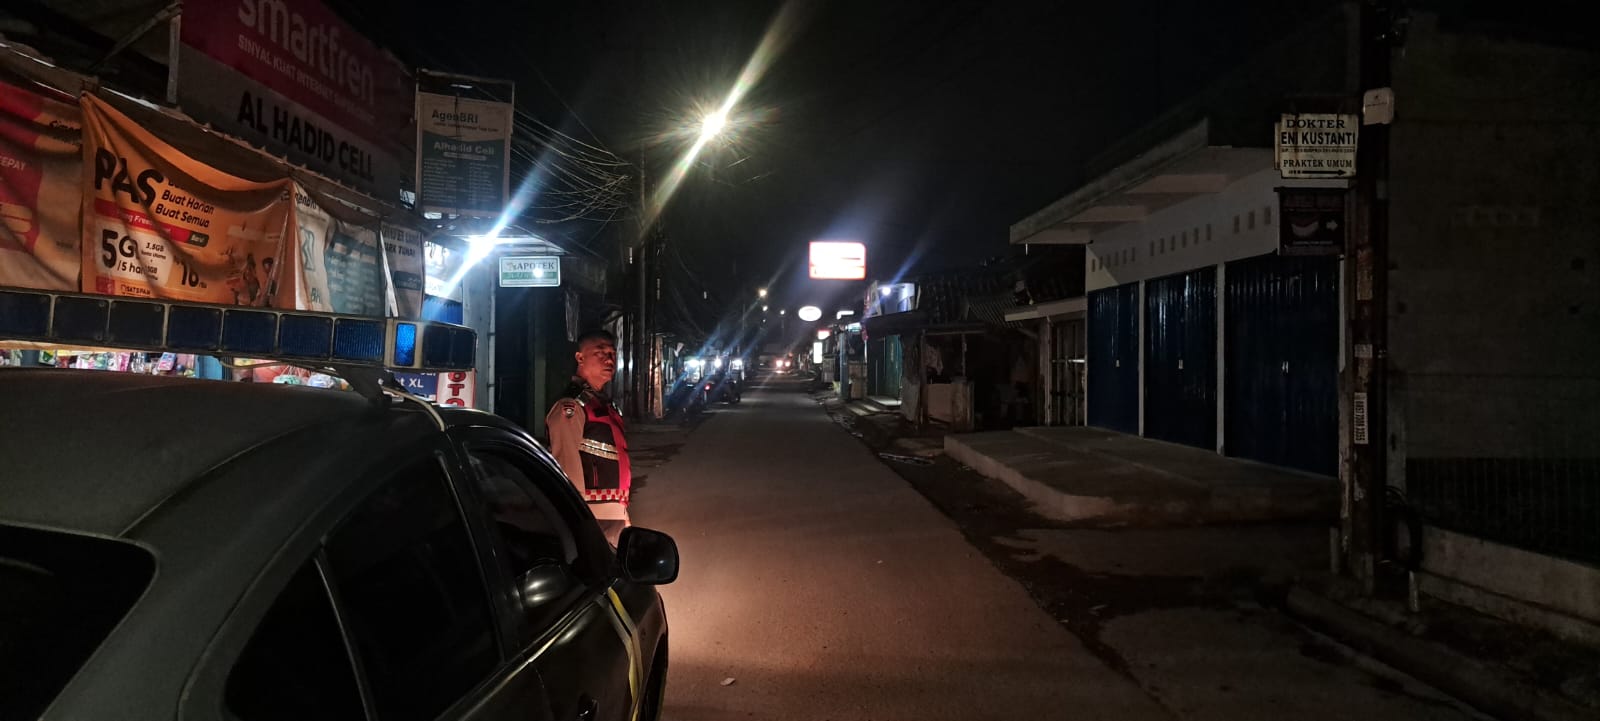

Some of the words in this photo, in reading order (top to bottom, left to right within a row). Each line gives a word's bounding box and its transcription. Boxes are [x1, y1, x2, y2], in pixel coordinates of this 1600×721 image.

[238, 34, 273, 66] SINYAL
[237, 90, 268, 136] AL
[273, 105, 335, 164] HADID
[338, 141, 376, 183] CELL
[1286, 119, 1346, 129] DOKTER
[1280, 131, 1299, 145] ENI
[1301, 131, 1356, 145] KUSTANTI
[1283, 159, 1324, 168] PRAKTEK
[1326, 159, 1353, 168] UMUM
[95, 147, 164, 209] PAS
[161, 189, 185, 207] Buat
[186, 197, 214, 215] Harian
[155, 203, 181, 221] Buat
[181, 211, 210, 228] Semua
[408, 378, 425, 389] XL
